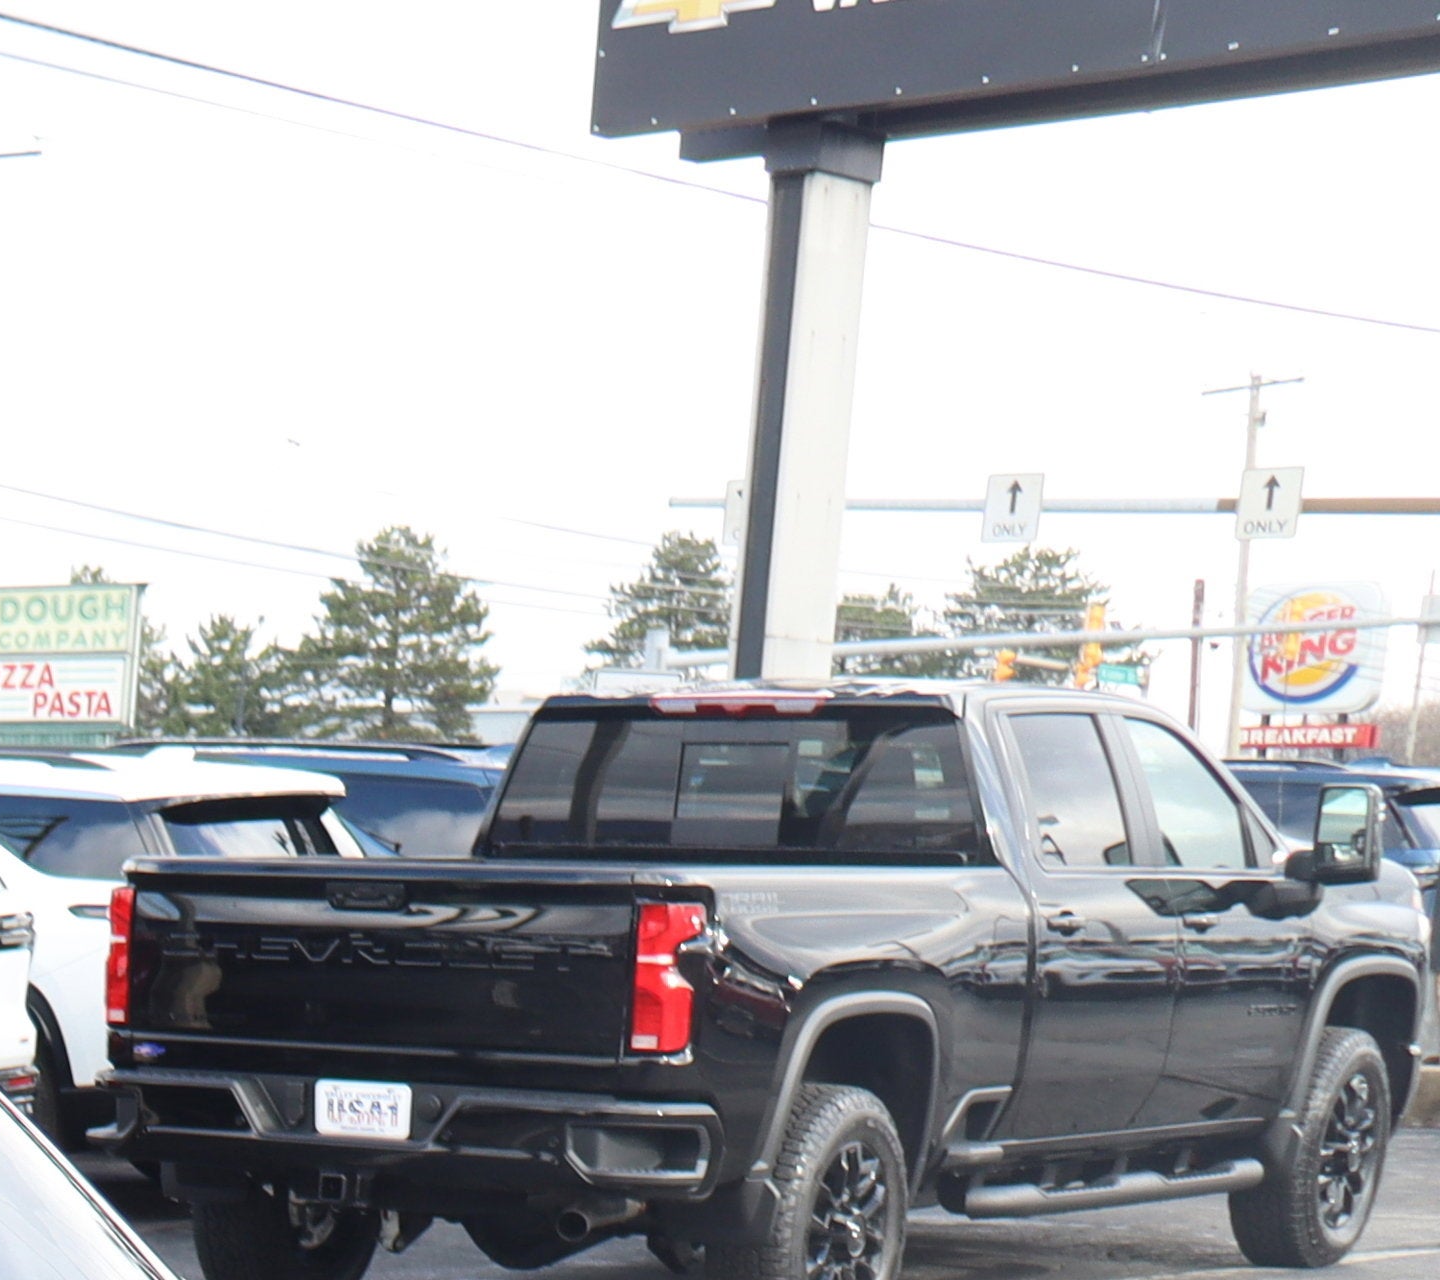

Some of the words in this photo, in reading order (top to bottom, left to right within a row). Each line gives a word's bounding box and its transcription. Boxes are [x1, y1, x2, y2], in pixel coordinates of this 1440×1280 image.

[992, 523, 1028, 537] ONLY
[1243, 519, 1288, 535] ONLY
[32, 690, 113, 718] PASTA
[163, 931, 613, 972] CHEVROLET
